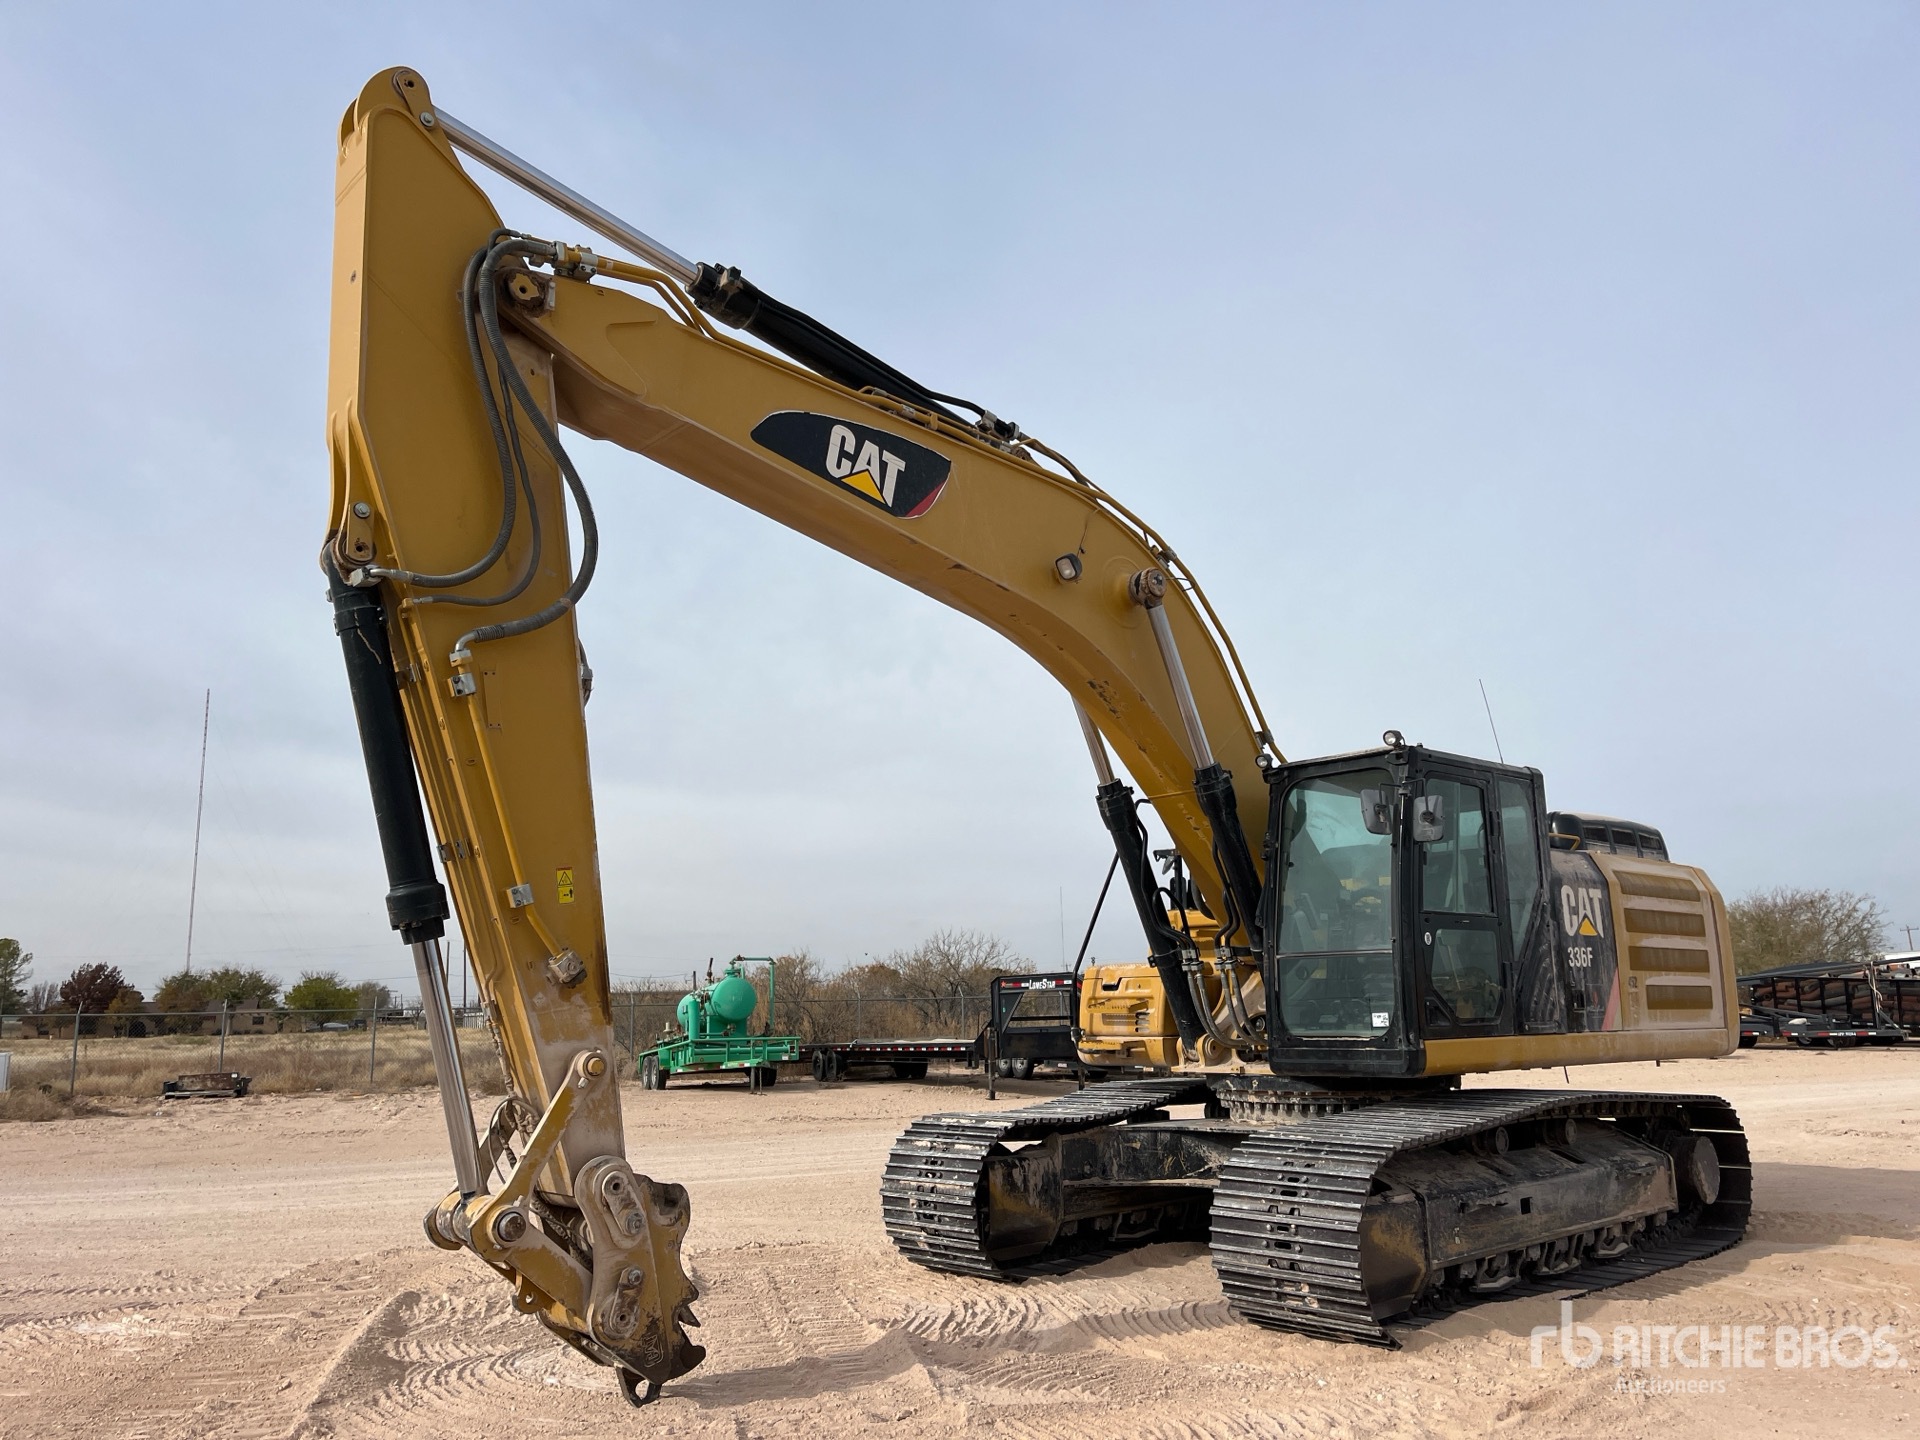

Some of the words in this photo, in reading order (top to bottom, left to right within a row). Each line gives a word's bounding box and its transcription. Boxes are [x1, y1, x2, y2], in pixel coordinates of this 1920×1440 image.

[825, 424, 906, 508] CAT
[1560, 884, 1604, 938] CAT
[1567, 946, 1593, 968] 336F
